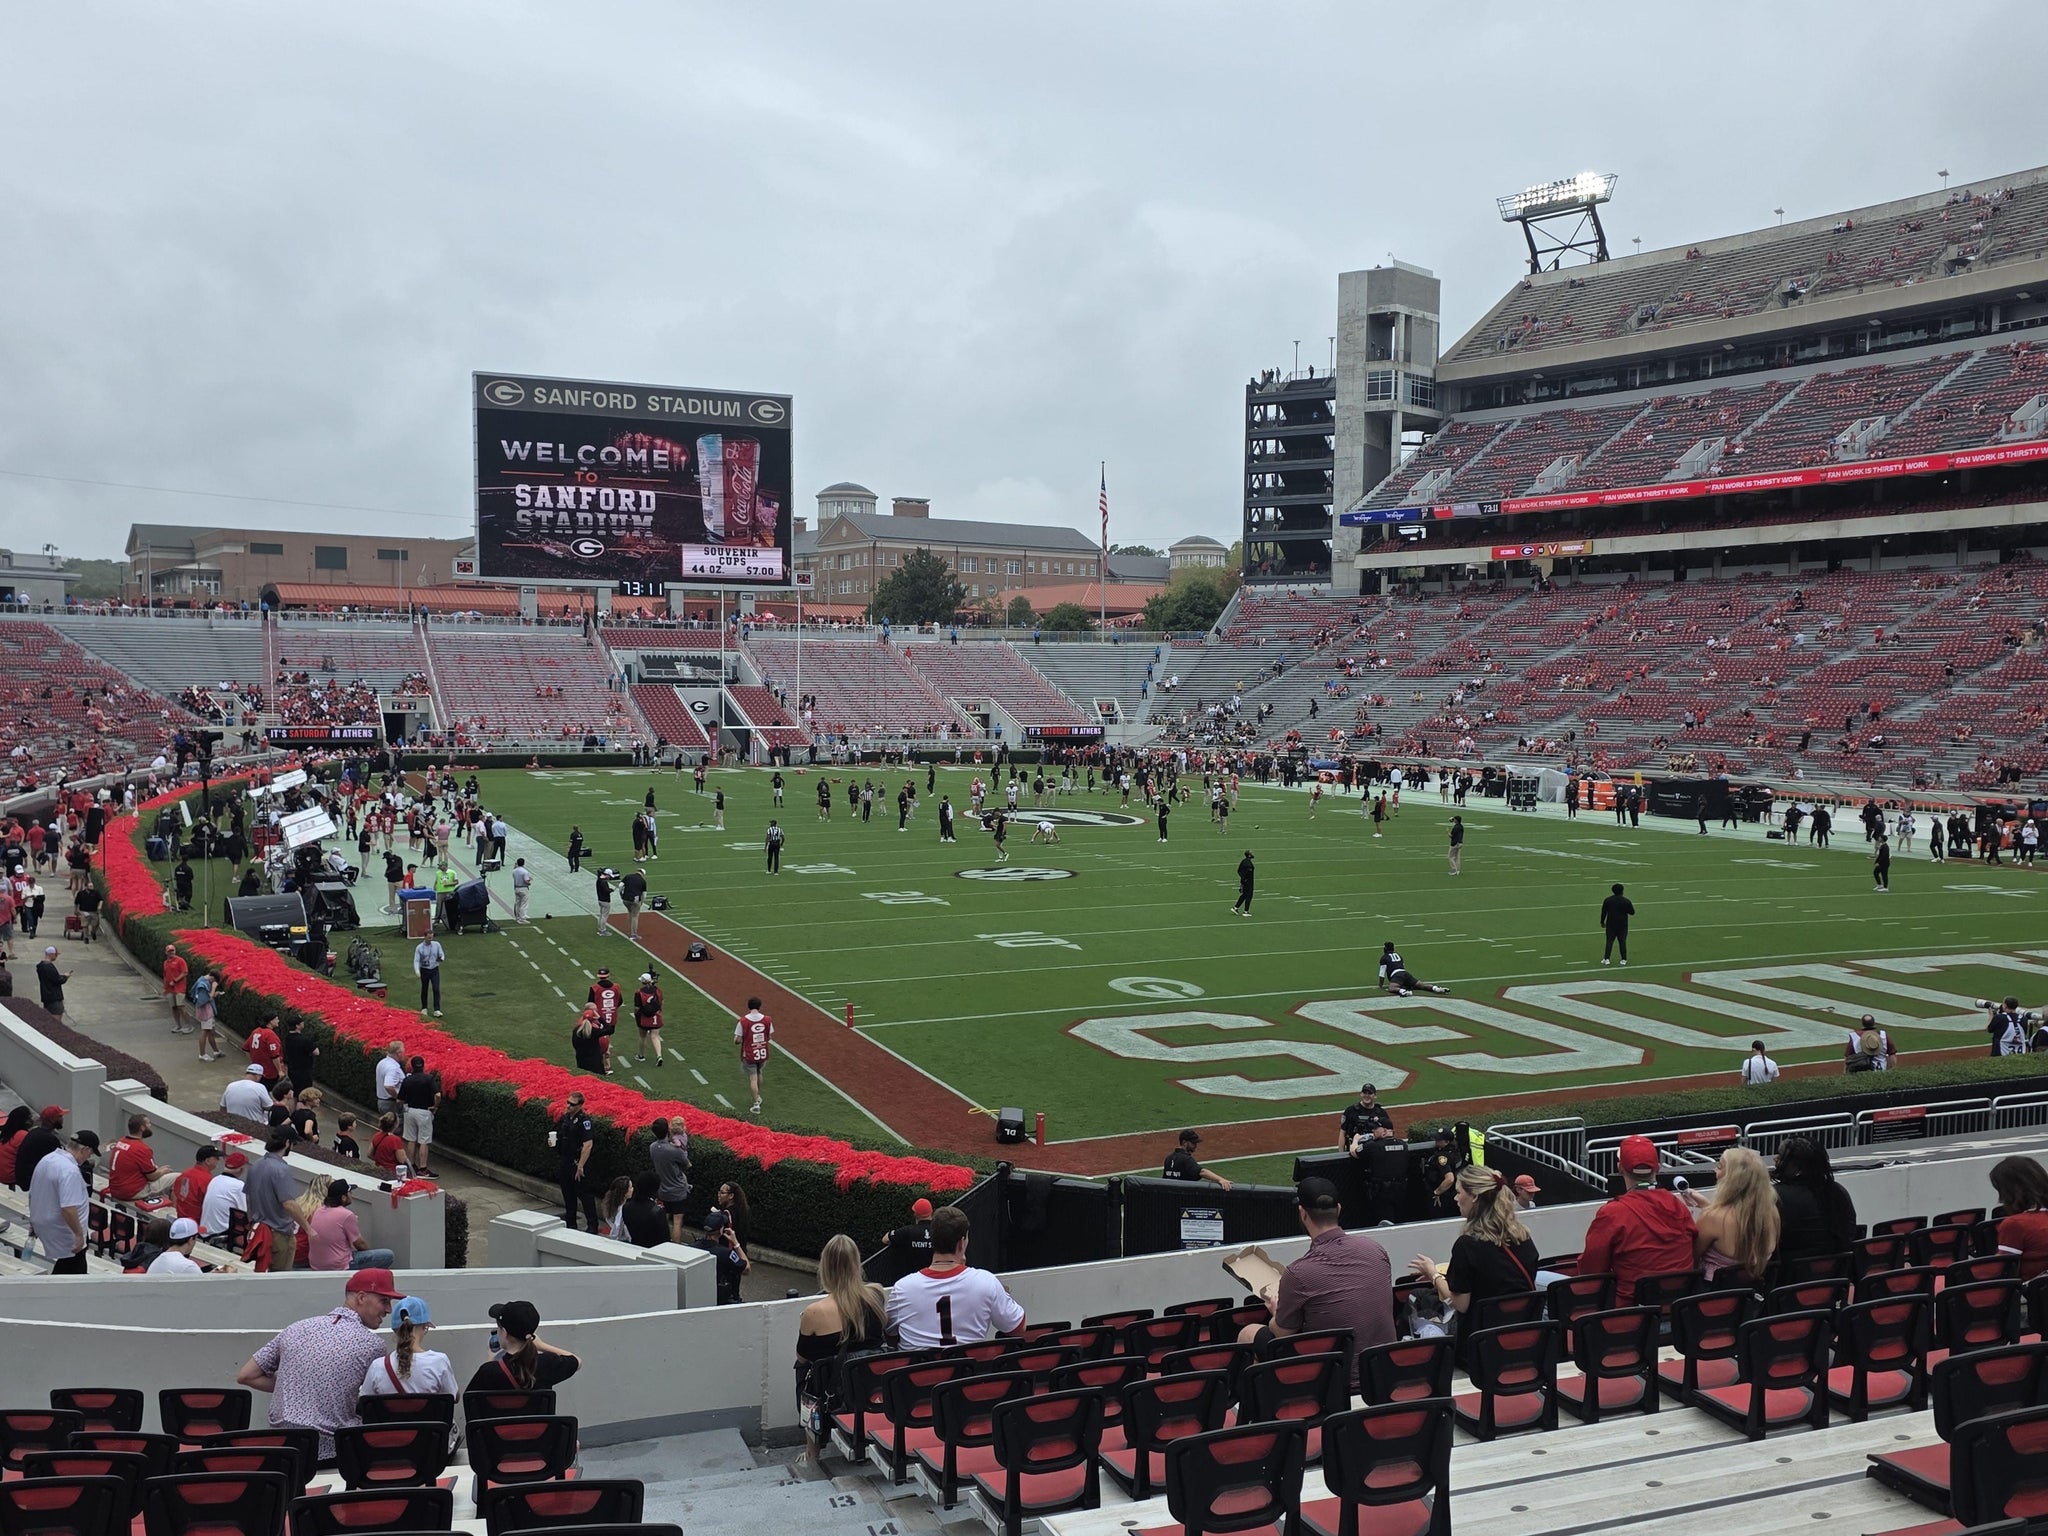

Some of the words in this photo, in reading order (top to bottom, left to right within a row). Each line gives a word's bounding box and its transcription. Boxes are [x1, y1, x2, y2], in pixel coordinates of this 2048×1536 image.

[534, 387, 637, 409] SANFORD
[647, 395, 741, 417] STADIUM
[501, 440, 669, 469] WELCOME
[1955, 456, 1971, 464] FAN
[1972, 453, 1996, 462] WORK
[1997, 452, 2005, 460] IS
[2006, 449, 2039, 459] THIRSTY
[1827, 470, 1841, 478] FAN
[1842, 468, 1864, 477] WORK
[1873, 464, 1903, 473] THIRSTY
[1905, 461, 1929, 469] WORK
[575, 471, 598, 483] TO
[1725, 481, 1746, 489] WORK
[1752, 478, 1781, 486] THIRSTY
[1781, 475, 1803, 483] WORK
[516, 484, 656, 513] SANFORD
[1617, 492, 1635, 500] WORK
[1643, 489, 1669, 498] THIRSTY
[1669, 487, 1689, 495] WORK
[1483, 504, 1499, 513] 73:11
[1544, 498, 1569, 507] THIRSTY
[1570, 497, 1589, 505] WORK
[516, 509, 654, 537] STADIUM
[704, 547, 759, 558] SOUVENIR
[457, 562, 474, 573] 25
[719, 556, 746, 566] CUPS
[692, 565, 705, 574] 44
[709, 565, 725, 574] OZ.
[746, 566, 774, 576] $7.00
[797, 574, 810, 584] 25
[623, 581, 663, 596] 73:11
[270, 729, 287, 738] IT'S
[289, 729, 329, 738] SATURDAY
[342, 729, 373, 738] ATHENS
[1029, 727, 1041, 735] IT'S
[1041, 727, 1071, 735] SATURDAY
[1079, 727, 1102, 735] ATHENS
[860, 891, 941, 905] 20
[974, 931, 1072, 948] 10
[1388, 952, 1402, 962] 10
[605, 1013, 612, 1024] 5
[753, 1048, 767, 1061] 39
[935, 1294, 958, 1347] 1
[829, 1494, 857, 1509] 13
